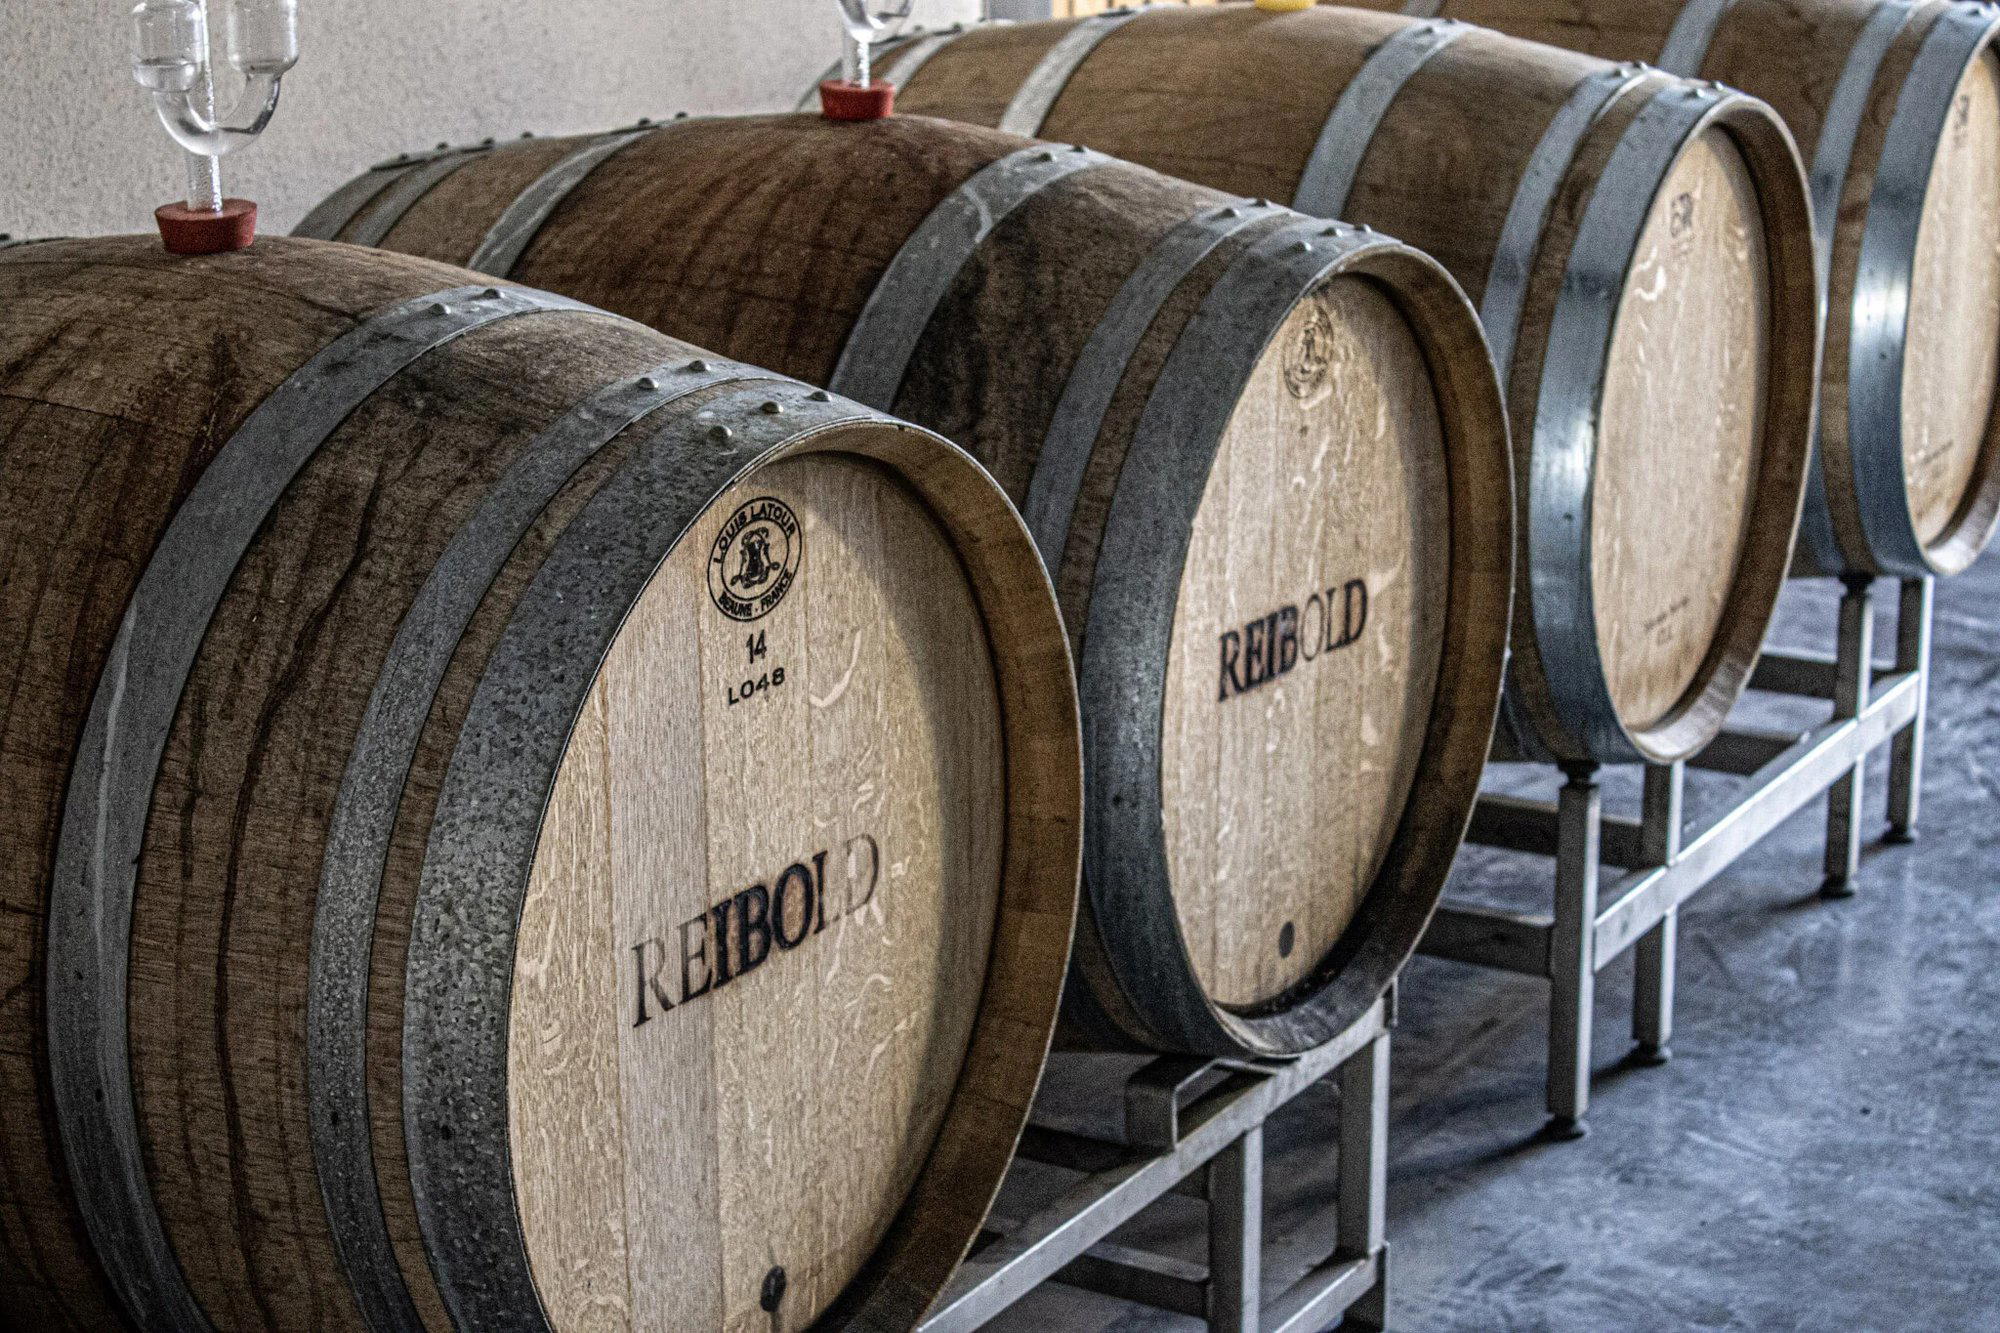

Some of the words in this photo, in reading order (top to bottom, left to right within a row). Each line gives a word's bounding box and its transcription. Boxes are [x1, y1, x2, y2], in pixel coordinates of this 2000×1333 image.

[714, 511, 749, 564] LOUIS
[750, 503, 796, 538] LATOUR
[718, 591, 753, 617] BEAUNE
[761, 570, 793, 612] FRANCE
[746, 629, 767, 664] 14
[1218, 578, 1368, 702] REIBOLD
[631, 834, 879, 1028] REIBOLD
